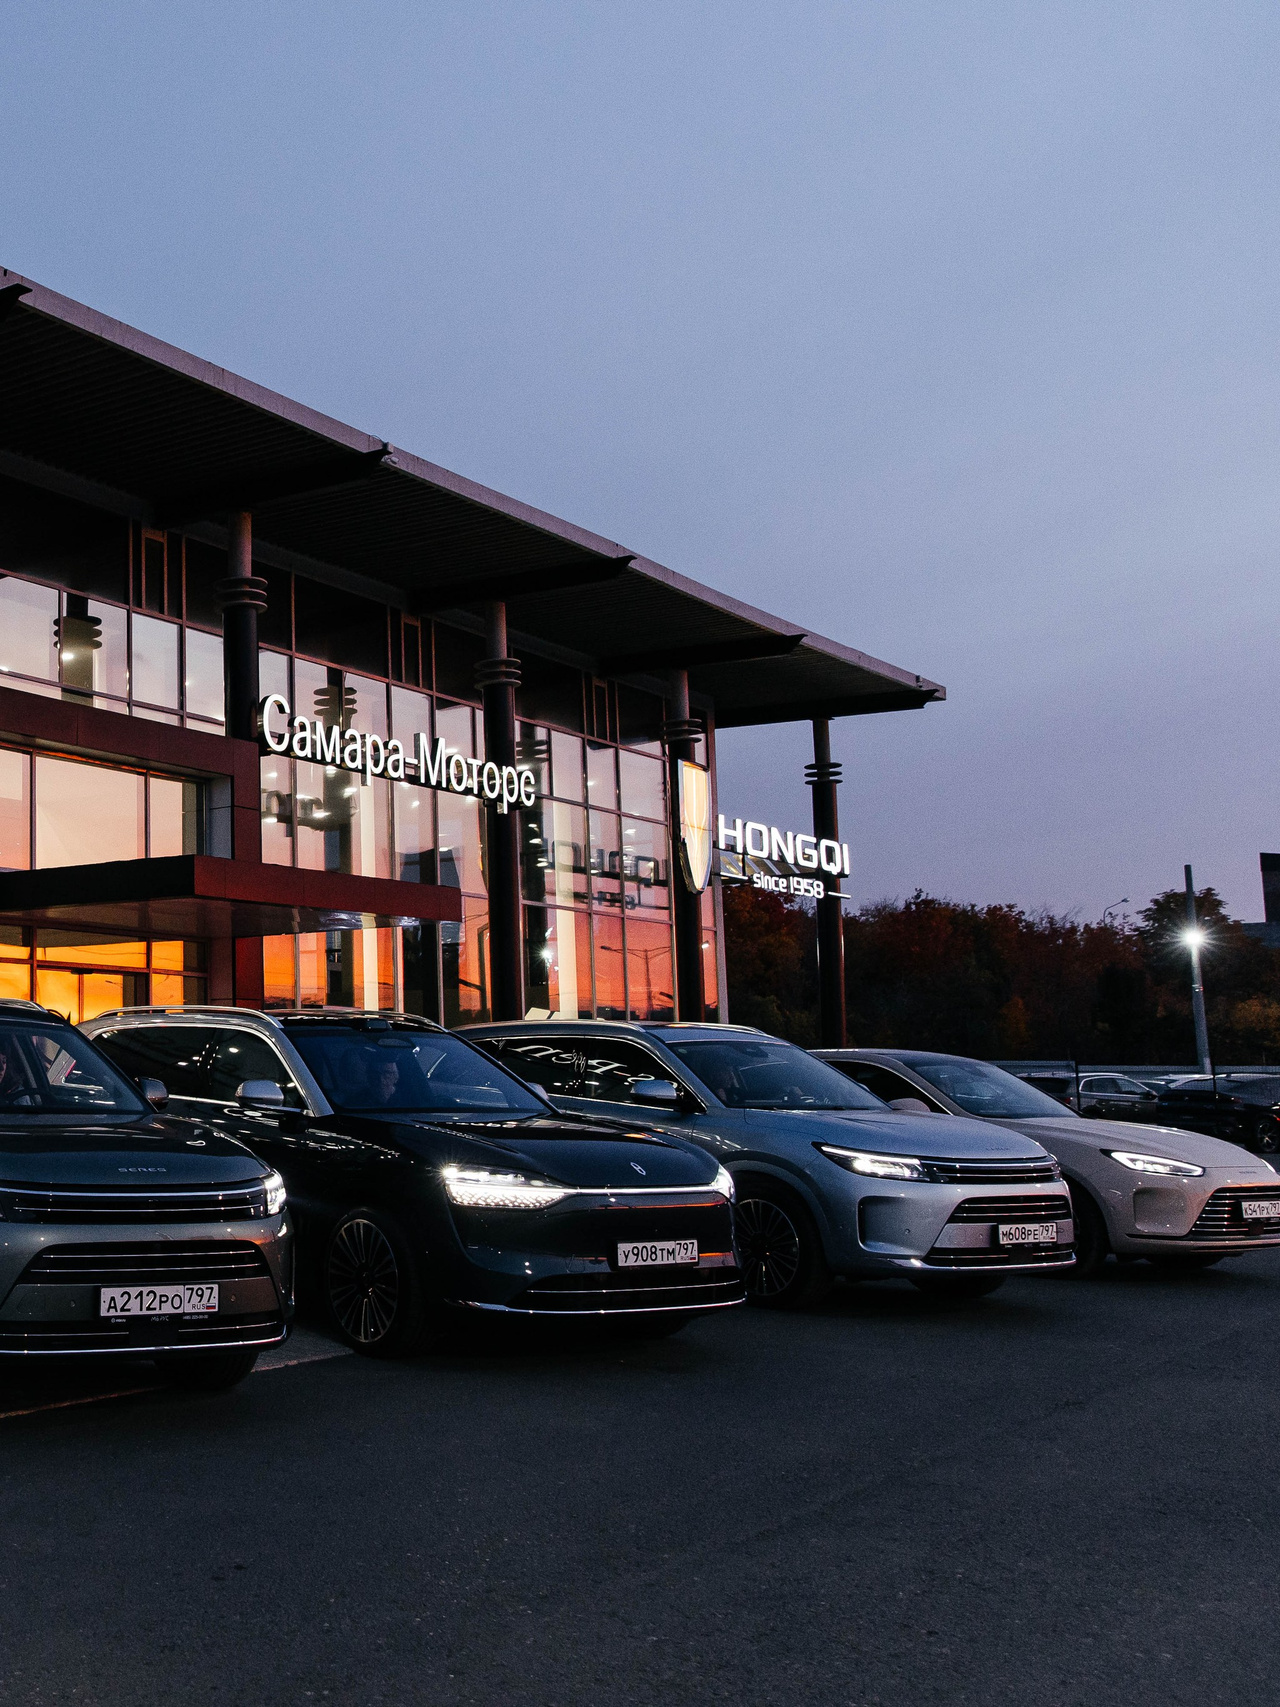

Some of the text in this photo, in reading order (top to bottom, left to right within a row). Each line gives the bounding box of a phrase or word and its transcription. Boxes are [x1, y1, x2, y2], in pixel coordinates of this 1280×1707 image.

[261, 693, 535, 814] Самара-Моторс
[718, 814, 850, 875] HONGQI
[753, 872, 824, 899] since 1958
[1001, 1225, 1054, 1241] М608РЕ 797
[623, 1241, 695, 1263] У908ТМ 797
[106, 1286, 215, 1313] А212РО 797
